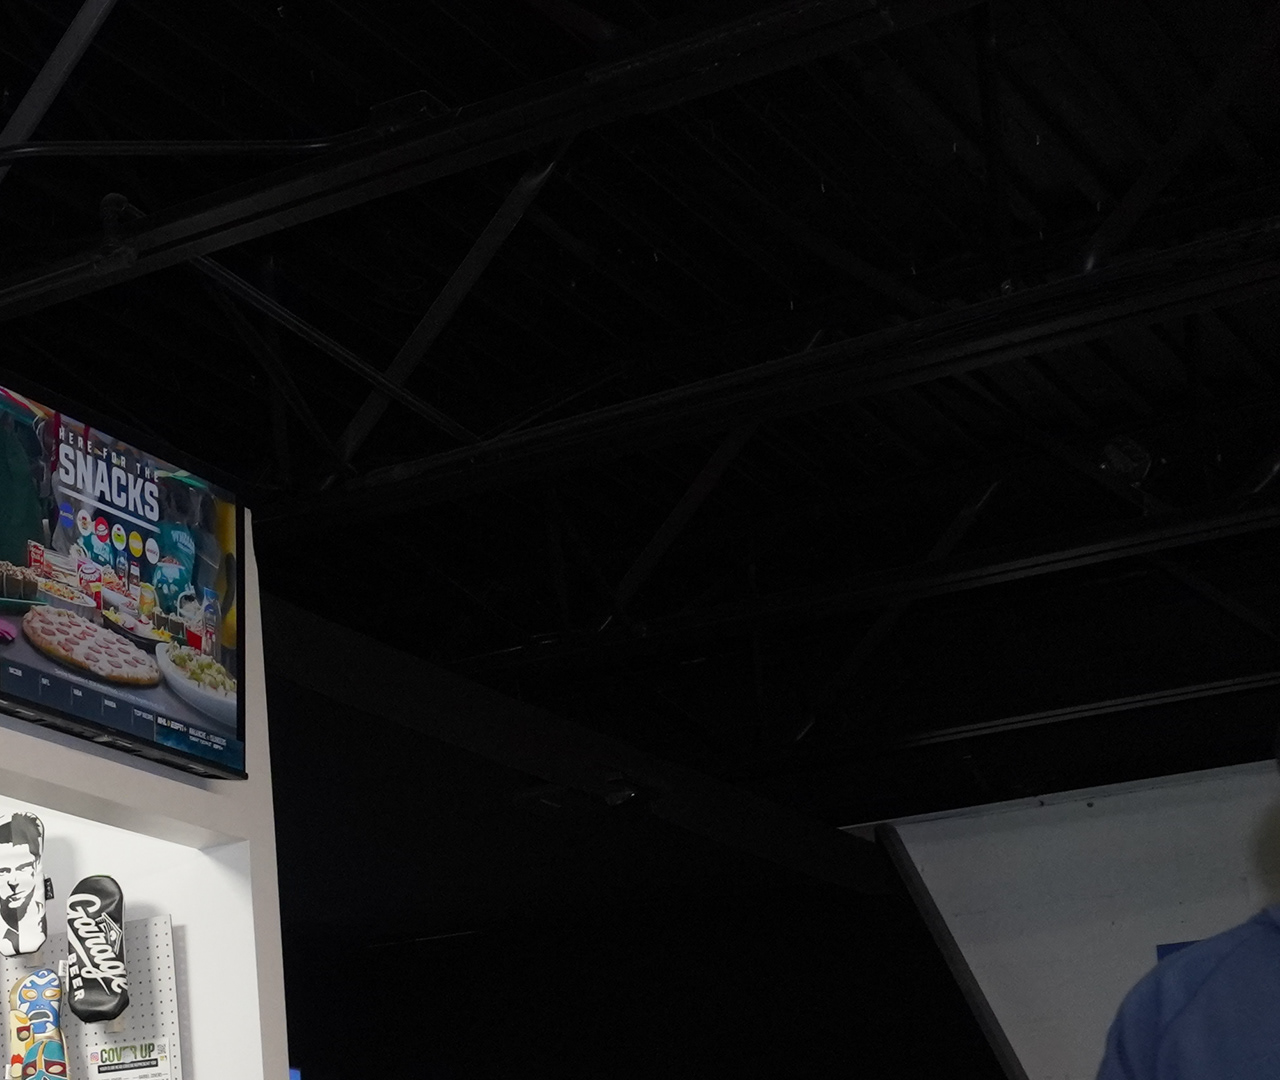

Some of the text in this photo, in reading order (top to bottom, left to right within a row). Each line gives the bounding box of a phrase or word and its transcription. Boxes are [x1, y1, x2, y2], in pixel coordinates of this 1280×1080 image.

[59, 426, 159, 482] HERE FOR THE
[59, 443, 160, 522] SNACKS
[68, 893, 128, 993] Garage
[68, 953, 85, 1001] BEER
[140, 1043, 155, 1059] UP
